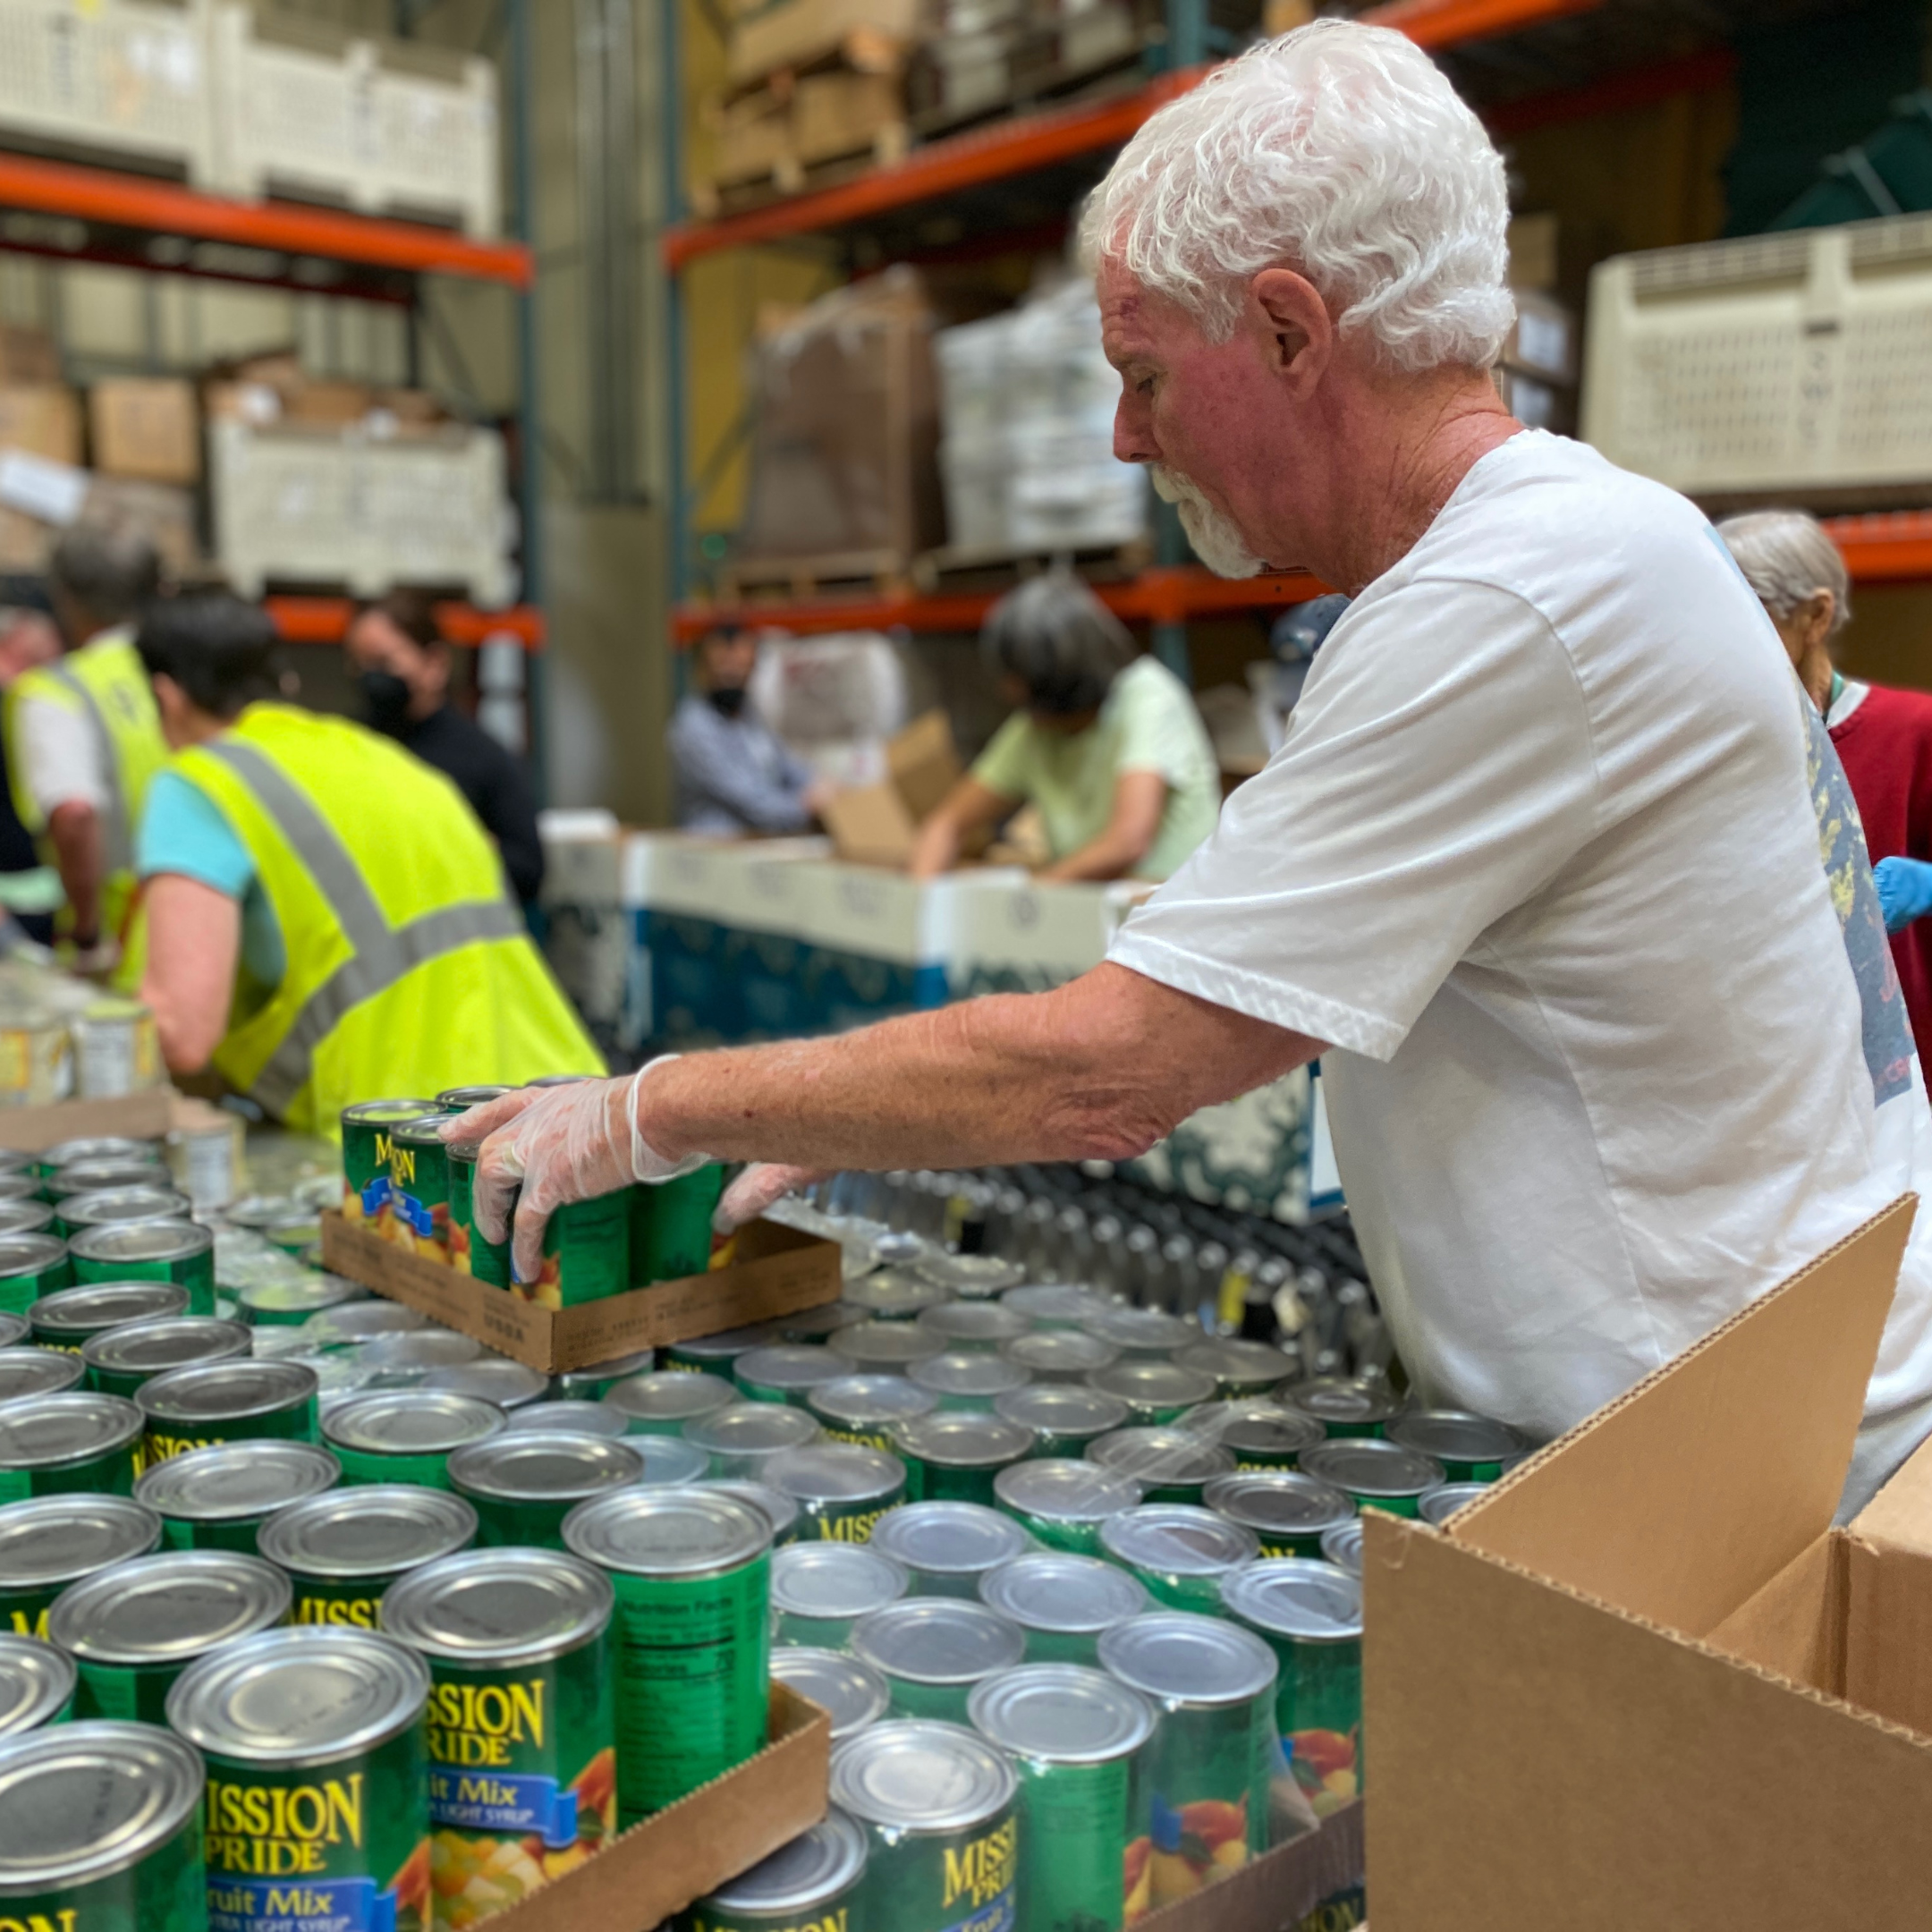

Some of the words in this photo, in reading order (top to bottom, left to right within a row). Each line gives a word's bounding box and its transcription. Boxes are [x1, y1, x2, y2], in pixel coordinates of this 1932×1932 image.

[457, 1776, 518, 1807] Mix
[207, 1772, 363, 1849] ISSION
[265, 1888, 334, 1917] Mix
